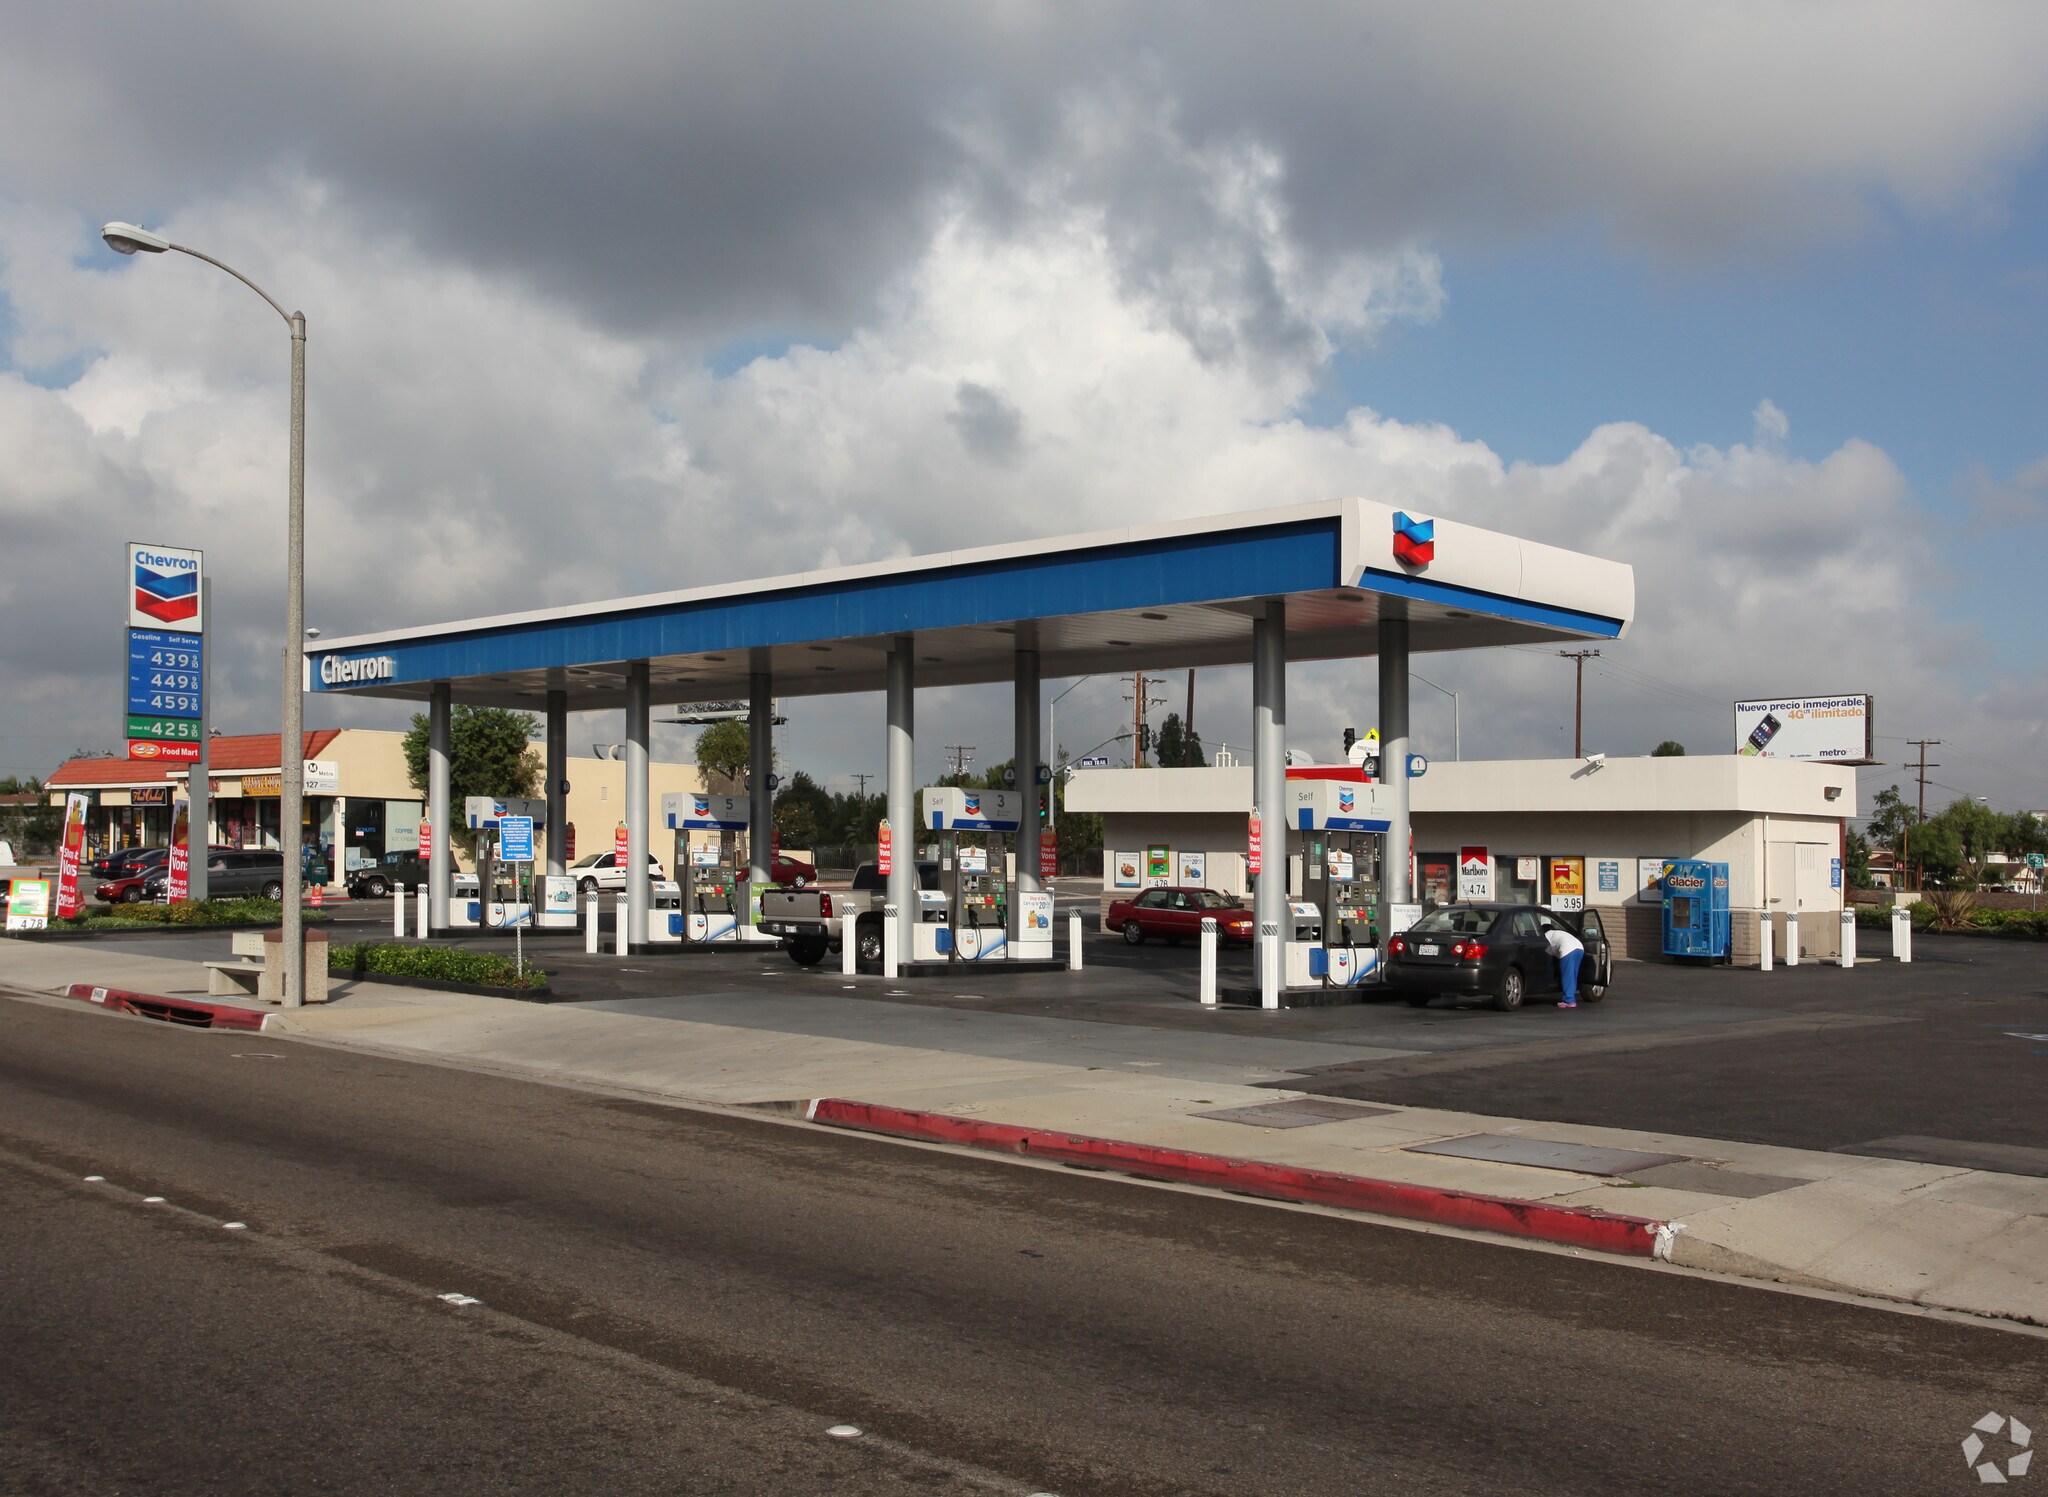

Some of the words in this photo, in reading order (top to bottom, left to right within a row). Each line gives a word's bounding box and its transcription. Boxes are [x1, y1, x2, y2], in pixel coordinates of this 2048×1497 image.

[135, 551, 198, 570] Chevron
[132, 632, 161, 641] Gasoline
[181, 637, 199, 645] Serve
[150, 652, 189, 667] 439
[320, 654, 394, 685] Chevron
[150, 674, 189, 688] 449
[150, 695, 189, 710] 459
[1737, 703, 1768, 712] Nuevo
[1770, 703, 1800, 712] precio
[1802, 698, 1865, 710] inmejorable.
[1788, 710, 1804, 720] 4G
[1812, 707, 1865, 719] ilimitado.
[150, 722, 188, 736] 425
[181, 748, 198, 756] Mart
[1368, 761, 1374, 770] 2
[1006, 770, 1012, 779] 4
[998, 794, 1004, 808] 3
[1298, 792, 1314, 801] Self
[1370, 788, 1375, 803] 1
[523, 802, 530, 812] 7
[726, 798, 734, 810] 5
[932, 797, 944, 806] Self
[172, 846, 184, 858] Shop
[880, 848, 890, 856] Vons
[1250, 842, 1260, 852] Vons
[1461, 864, 1488, 875] Marlboro
[1555, 882, 1578, 890] Marlboro
[1668, 876, 1704, 888] Glacier
[1470, 884, 1486, 895] 4.74
[1564, 898, 1581, 909] 3.95
